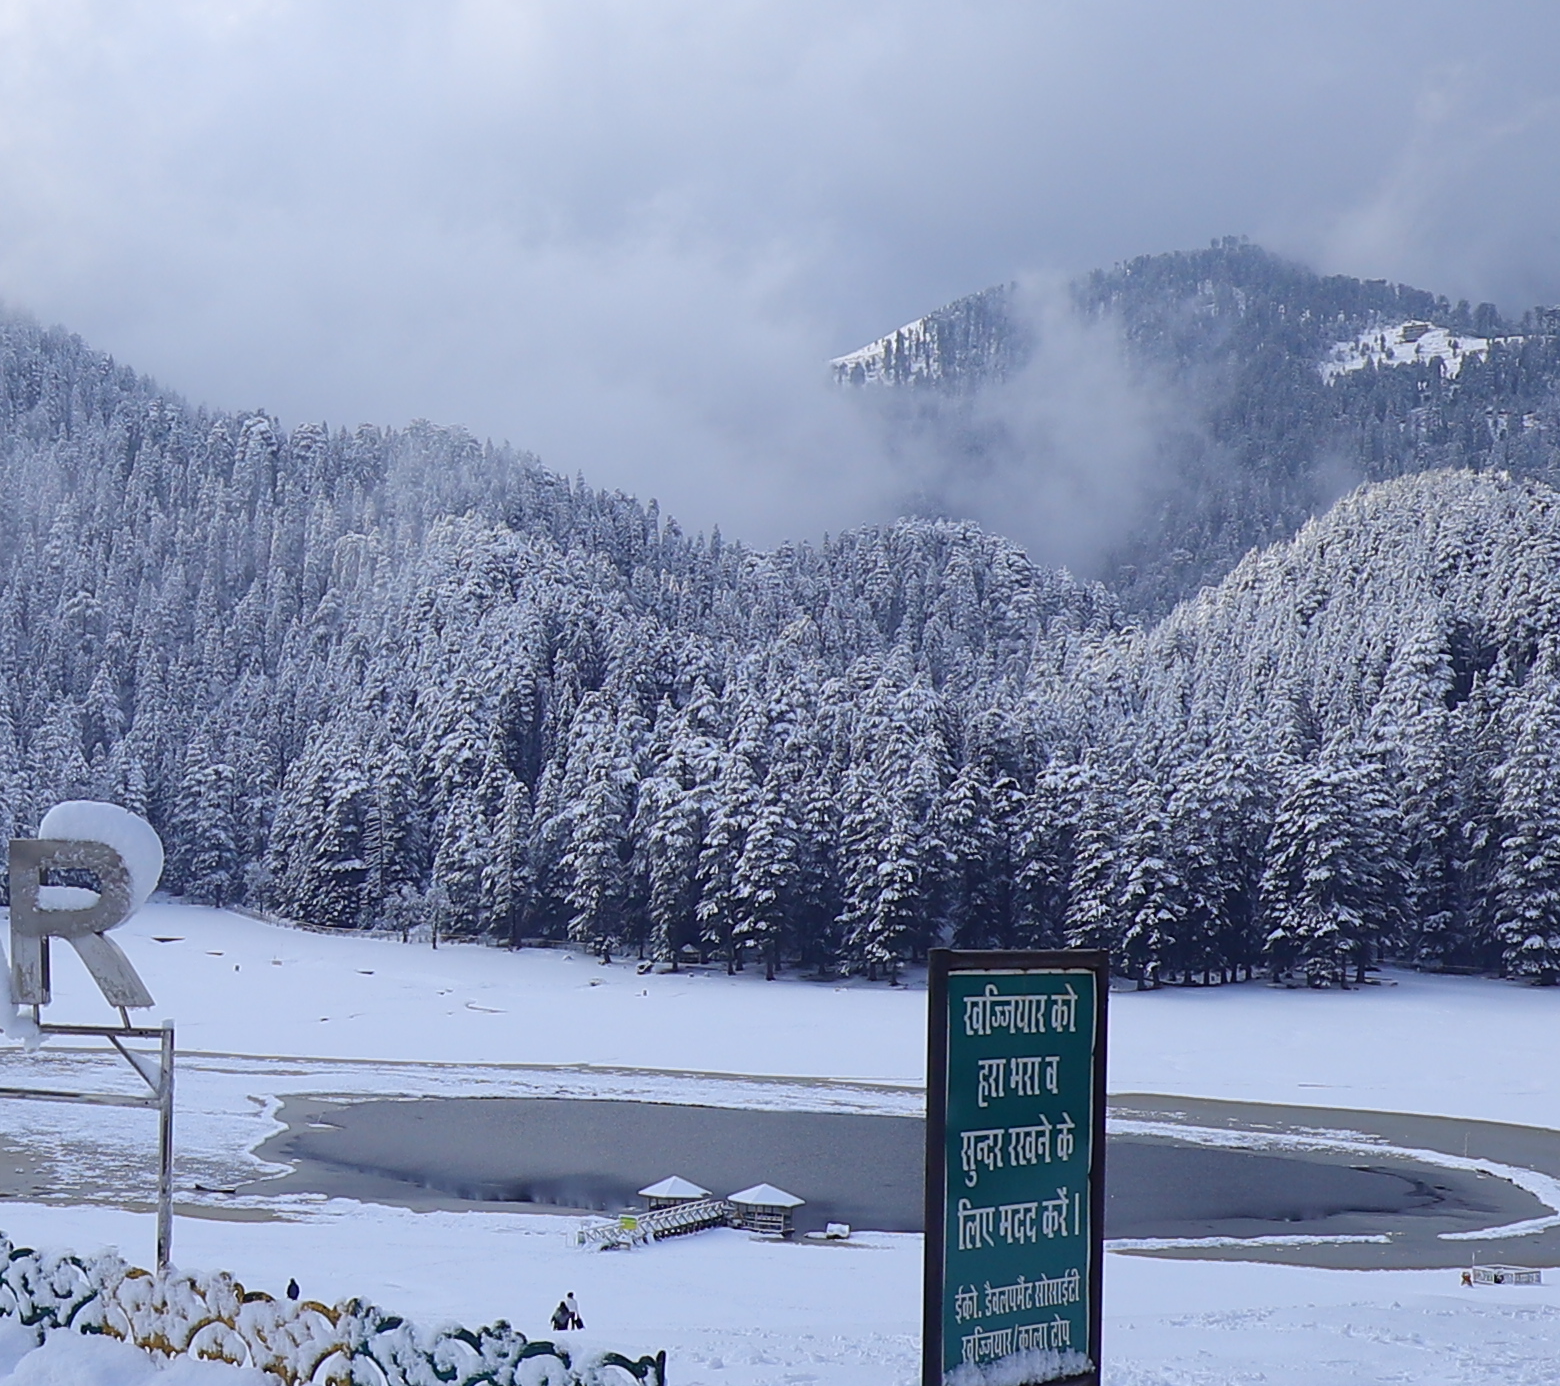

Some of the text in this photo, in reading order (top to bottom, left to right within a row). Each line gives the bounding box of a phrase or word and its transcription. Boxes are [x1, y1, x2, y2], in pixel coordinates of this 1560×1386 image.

[963, 983, 1078, 1035] खज्जियार को
[978, 1056, 1060, 1107] हरा भरा व
[960, 1112, 1075, 1187] सुन्दर रखने के
[958, 1198, 995, 1250] लिए
[999, 1202, 1038, 1244] मदद
[1050, 1313, 1071, 1348] टोप
